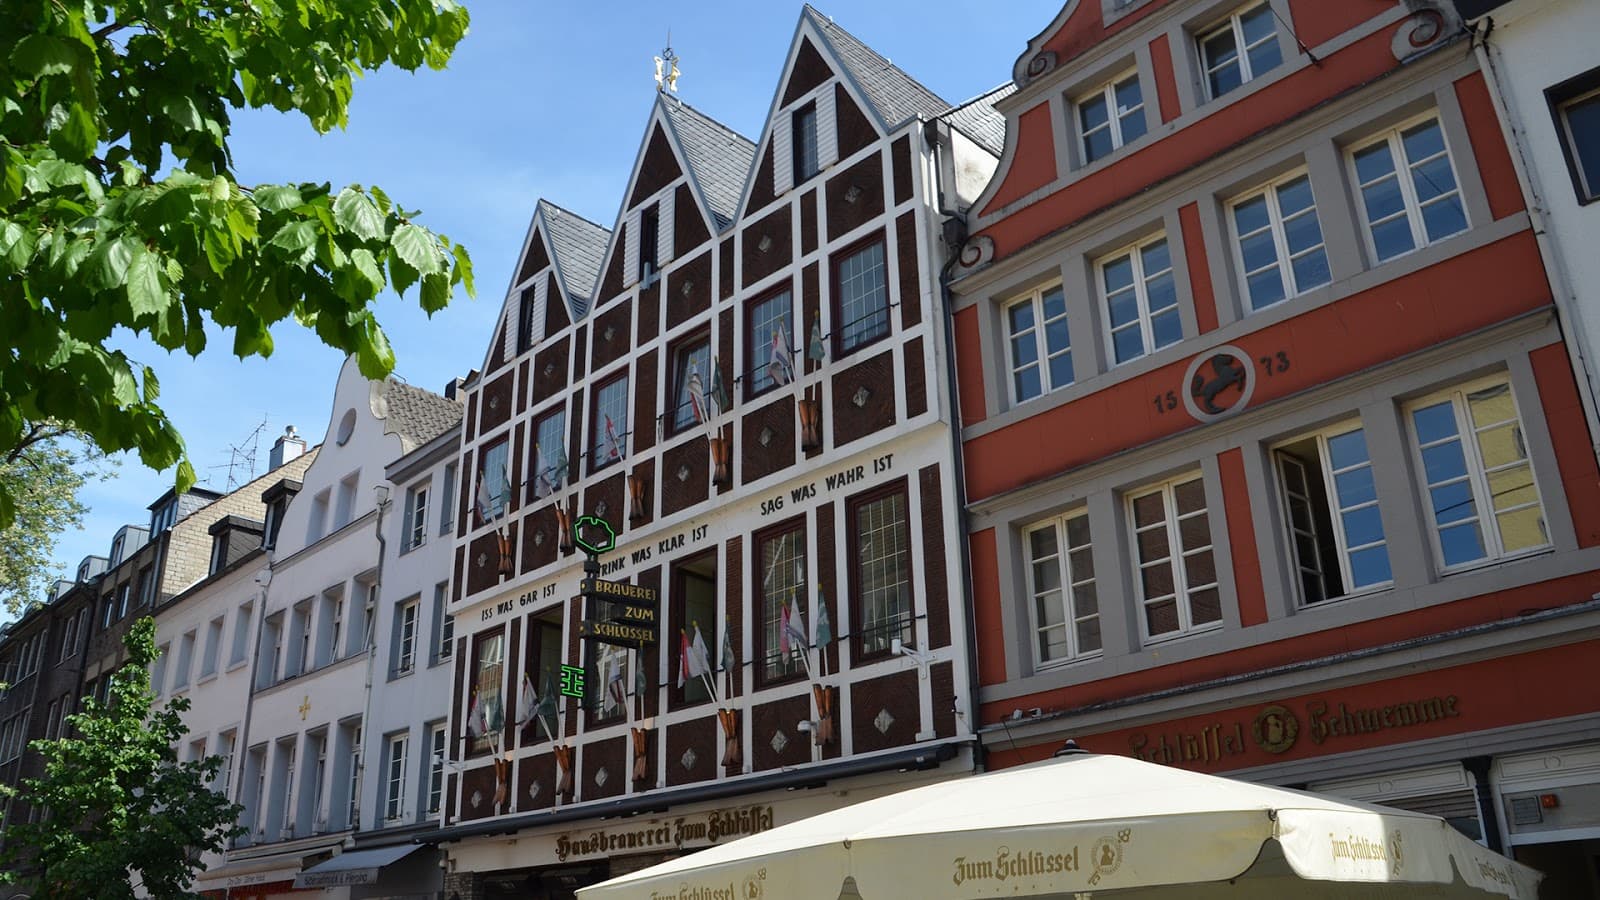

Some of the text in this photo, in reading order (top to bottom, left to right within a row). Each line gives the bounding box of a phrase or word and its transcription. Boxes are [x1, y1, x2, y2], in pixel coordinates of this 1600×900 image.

[1154, 351, 1290, 414] 15 73
[760, 453, 894, 516] SAG WAS WAHR IST
[599, 524, 708, 577] RINK WAS KLAR IST
[481, 583, 556, 621] ISS WAS GAR IST
[595, 580, 656, 600] BRAUEREI
[594, 623, 655, 641] SCHLÜSSEL
[625, 606, 654, 621] ZUM
[1306, 695, 1460, 745] Schwemme
[555, 821, 670, 862] Hausbrauerei
[674, 817, 706, 846] Zum
[953, 857, 994, 886] Zum
[995, 845, 1080, 881] Schlüssel
